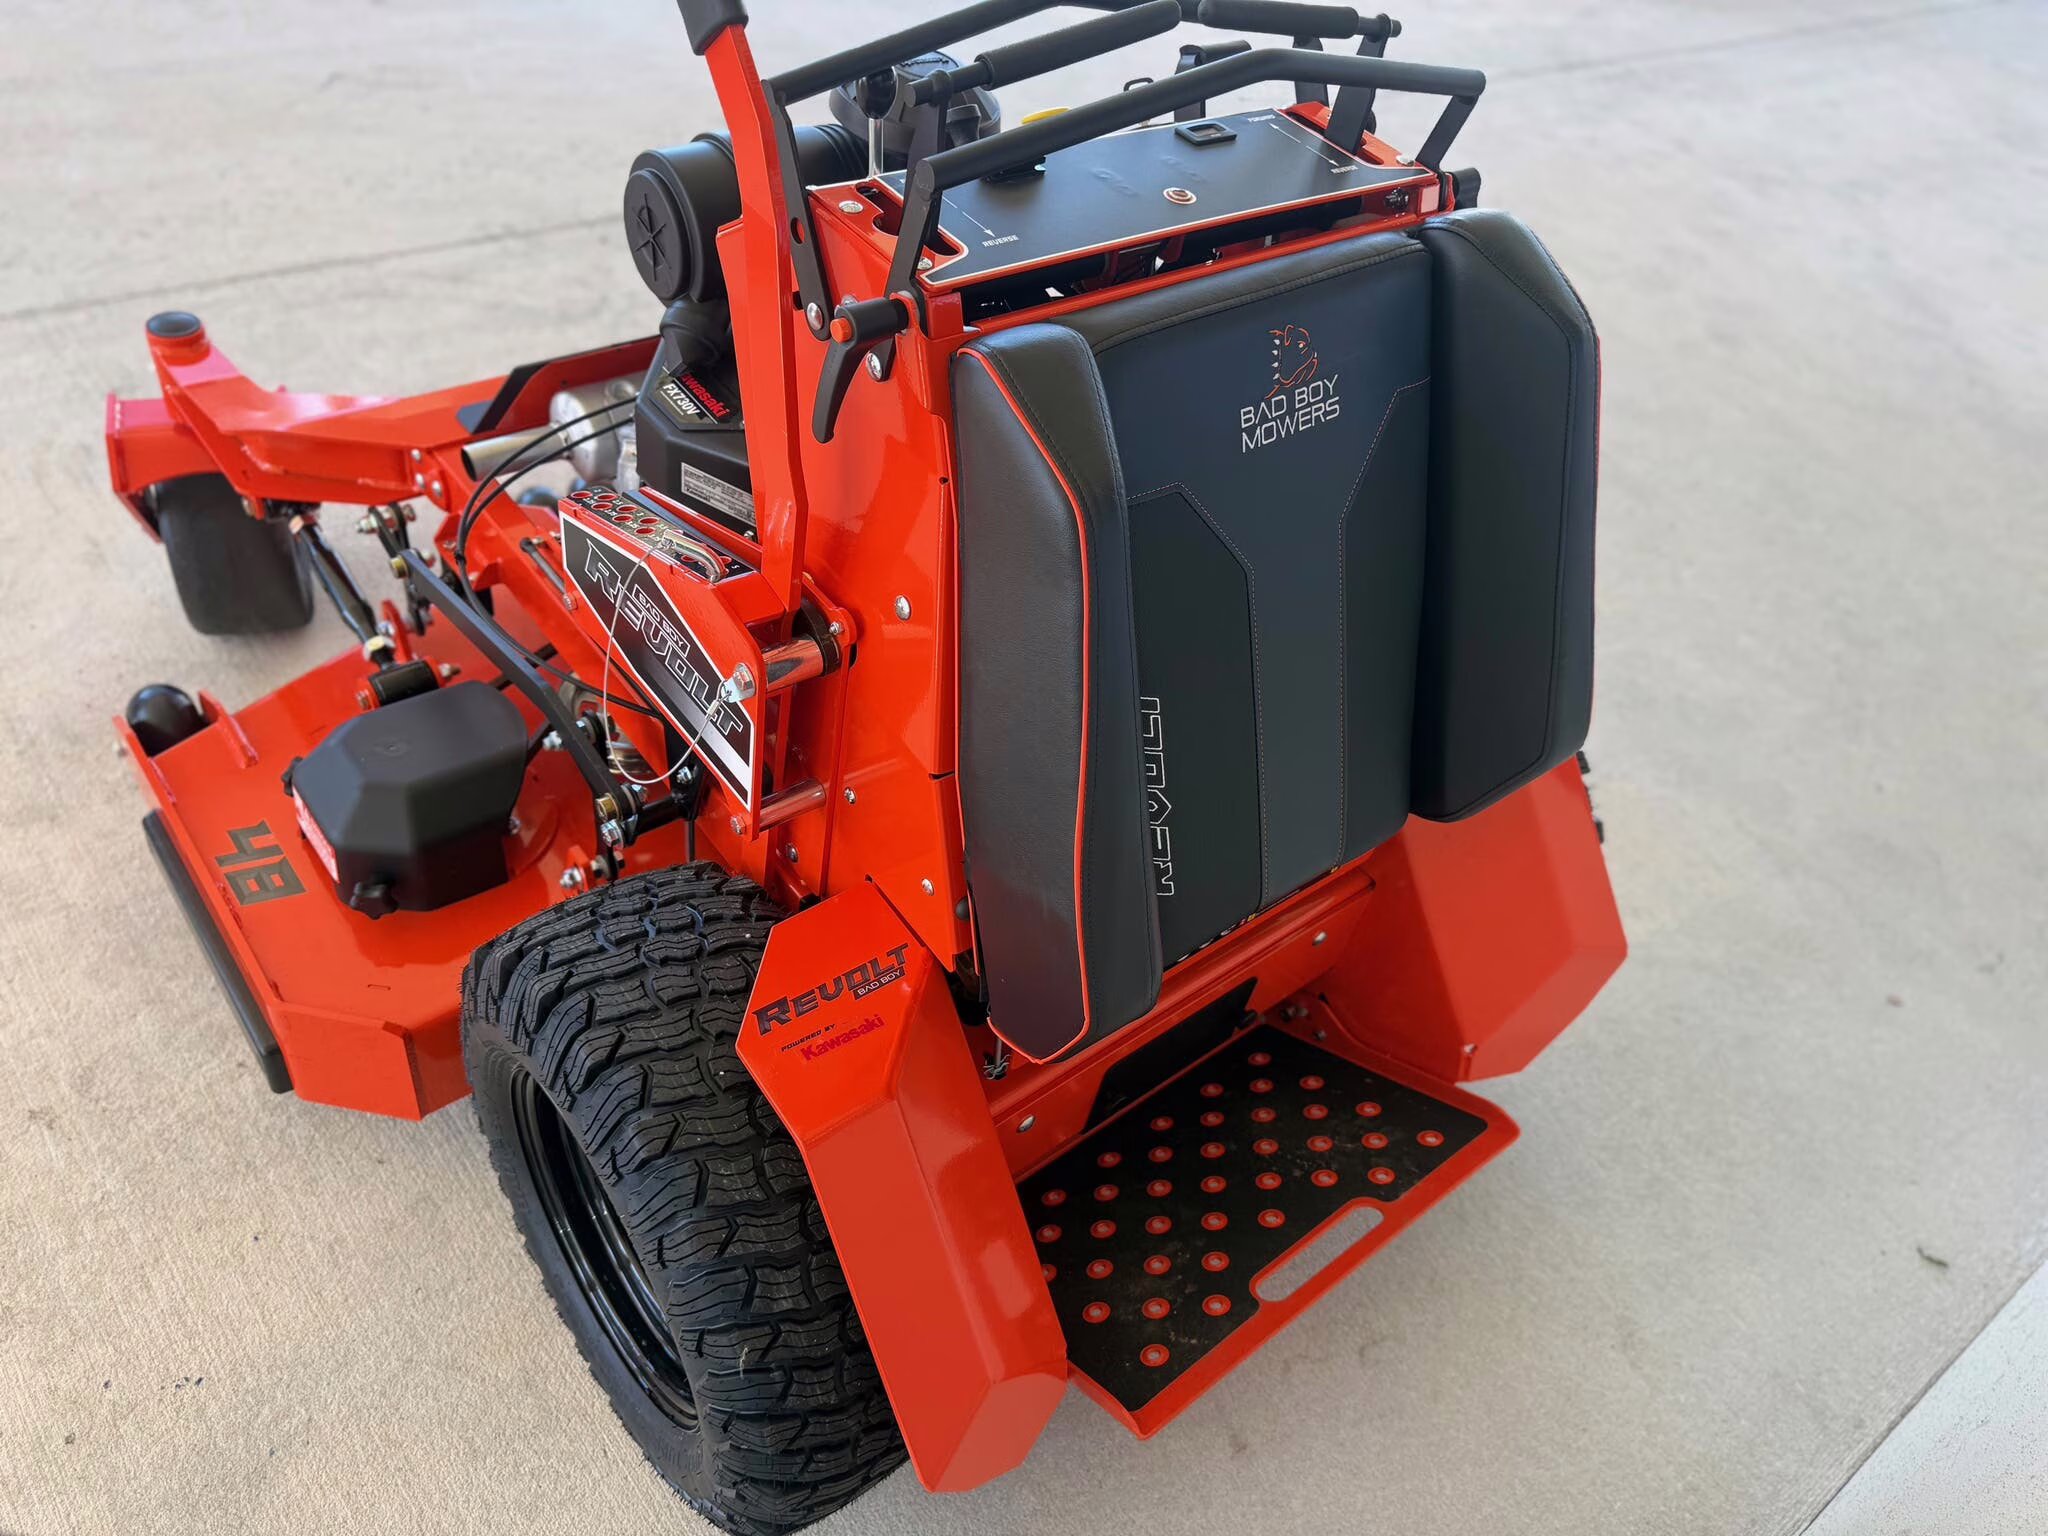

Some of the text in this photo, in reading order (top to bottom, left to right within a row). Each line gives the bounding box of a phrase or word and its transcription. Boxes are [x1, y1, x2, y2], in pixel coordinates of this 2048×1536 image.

[982, 234, 1019, 248] REVERSE
[663, 383, 701, 415] FX730V
[680, 373, 731, 419] awasaki
[1240, 374, 1339, 429] BAD BOY
[1241, 396, 1340, 453] MOWERS
[583, 538, 744, 737] REVOLT
[638, 592, 684, 648] BAD BOY
[214, 819, 308, 906] 48
[752, 942, 909, 1037] REVOLT
[857, 969, 902, 996] BAD BOY
[781, 1023, 836, 1052] POWERED BY
[800, 1013, 885, 1062] Kawasaki
